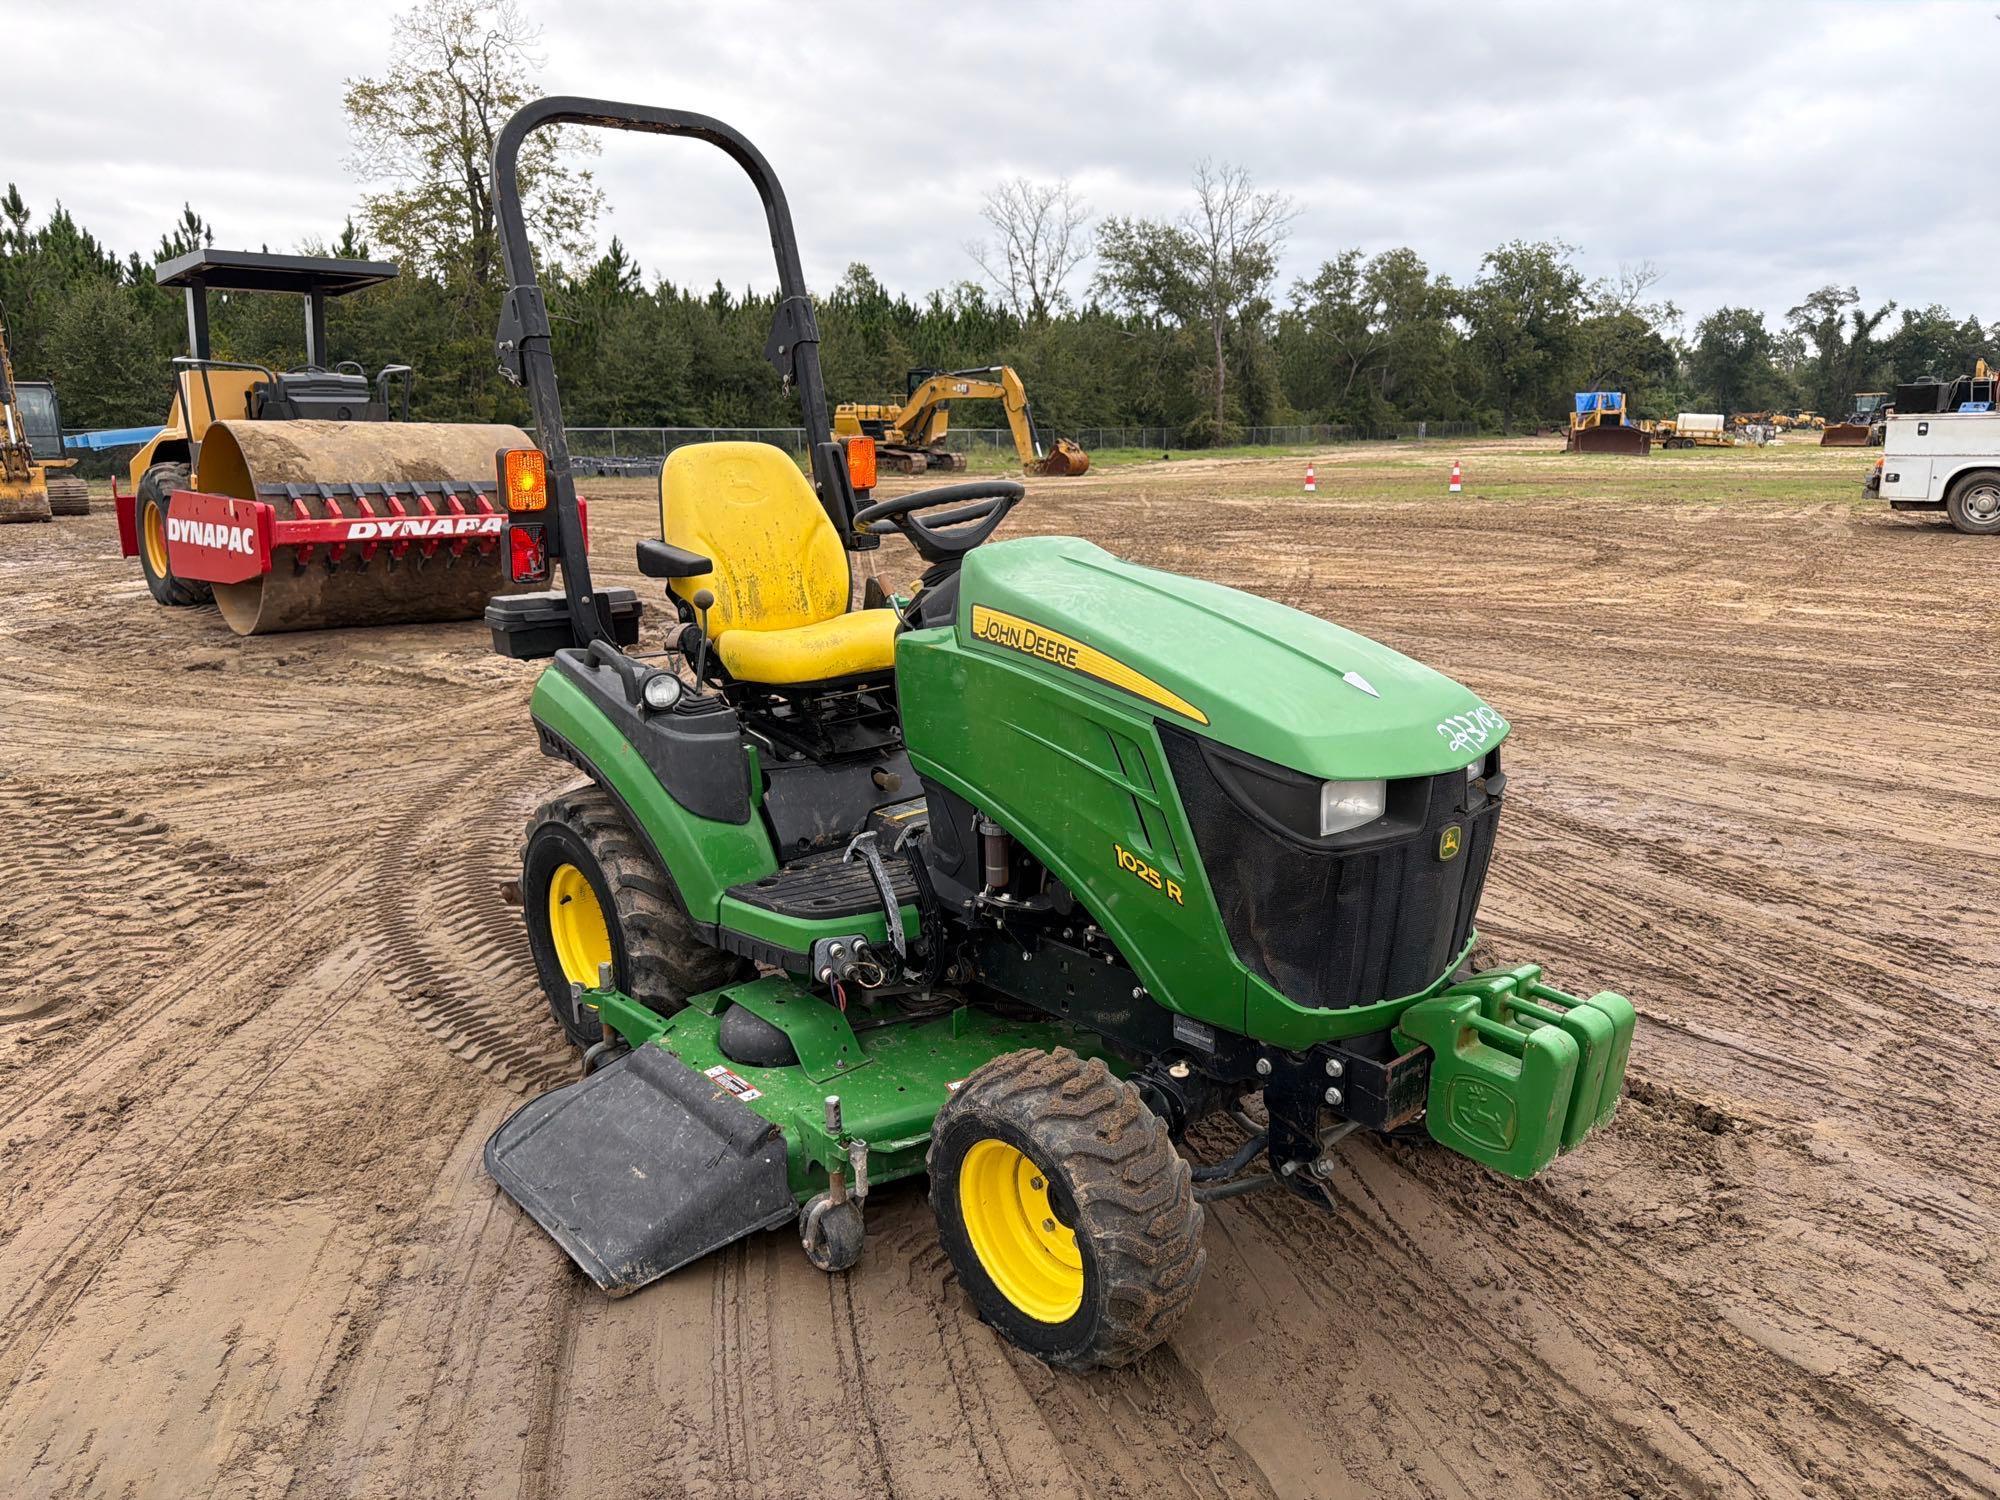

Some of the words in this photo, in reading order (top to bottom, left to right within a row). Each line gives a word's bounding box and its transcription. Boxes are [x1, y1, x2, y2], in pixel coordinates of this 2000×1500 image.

[168, 517, 254, 555] DYNAPAC
[347, 517, 502, 540] DYNAPA
[980, 616, 1021, 646] JOHN
[1023, 628, 1079, 667] DEERE
